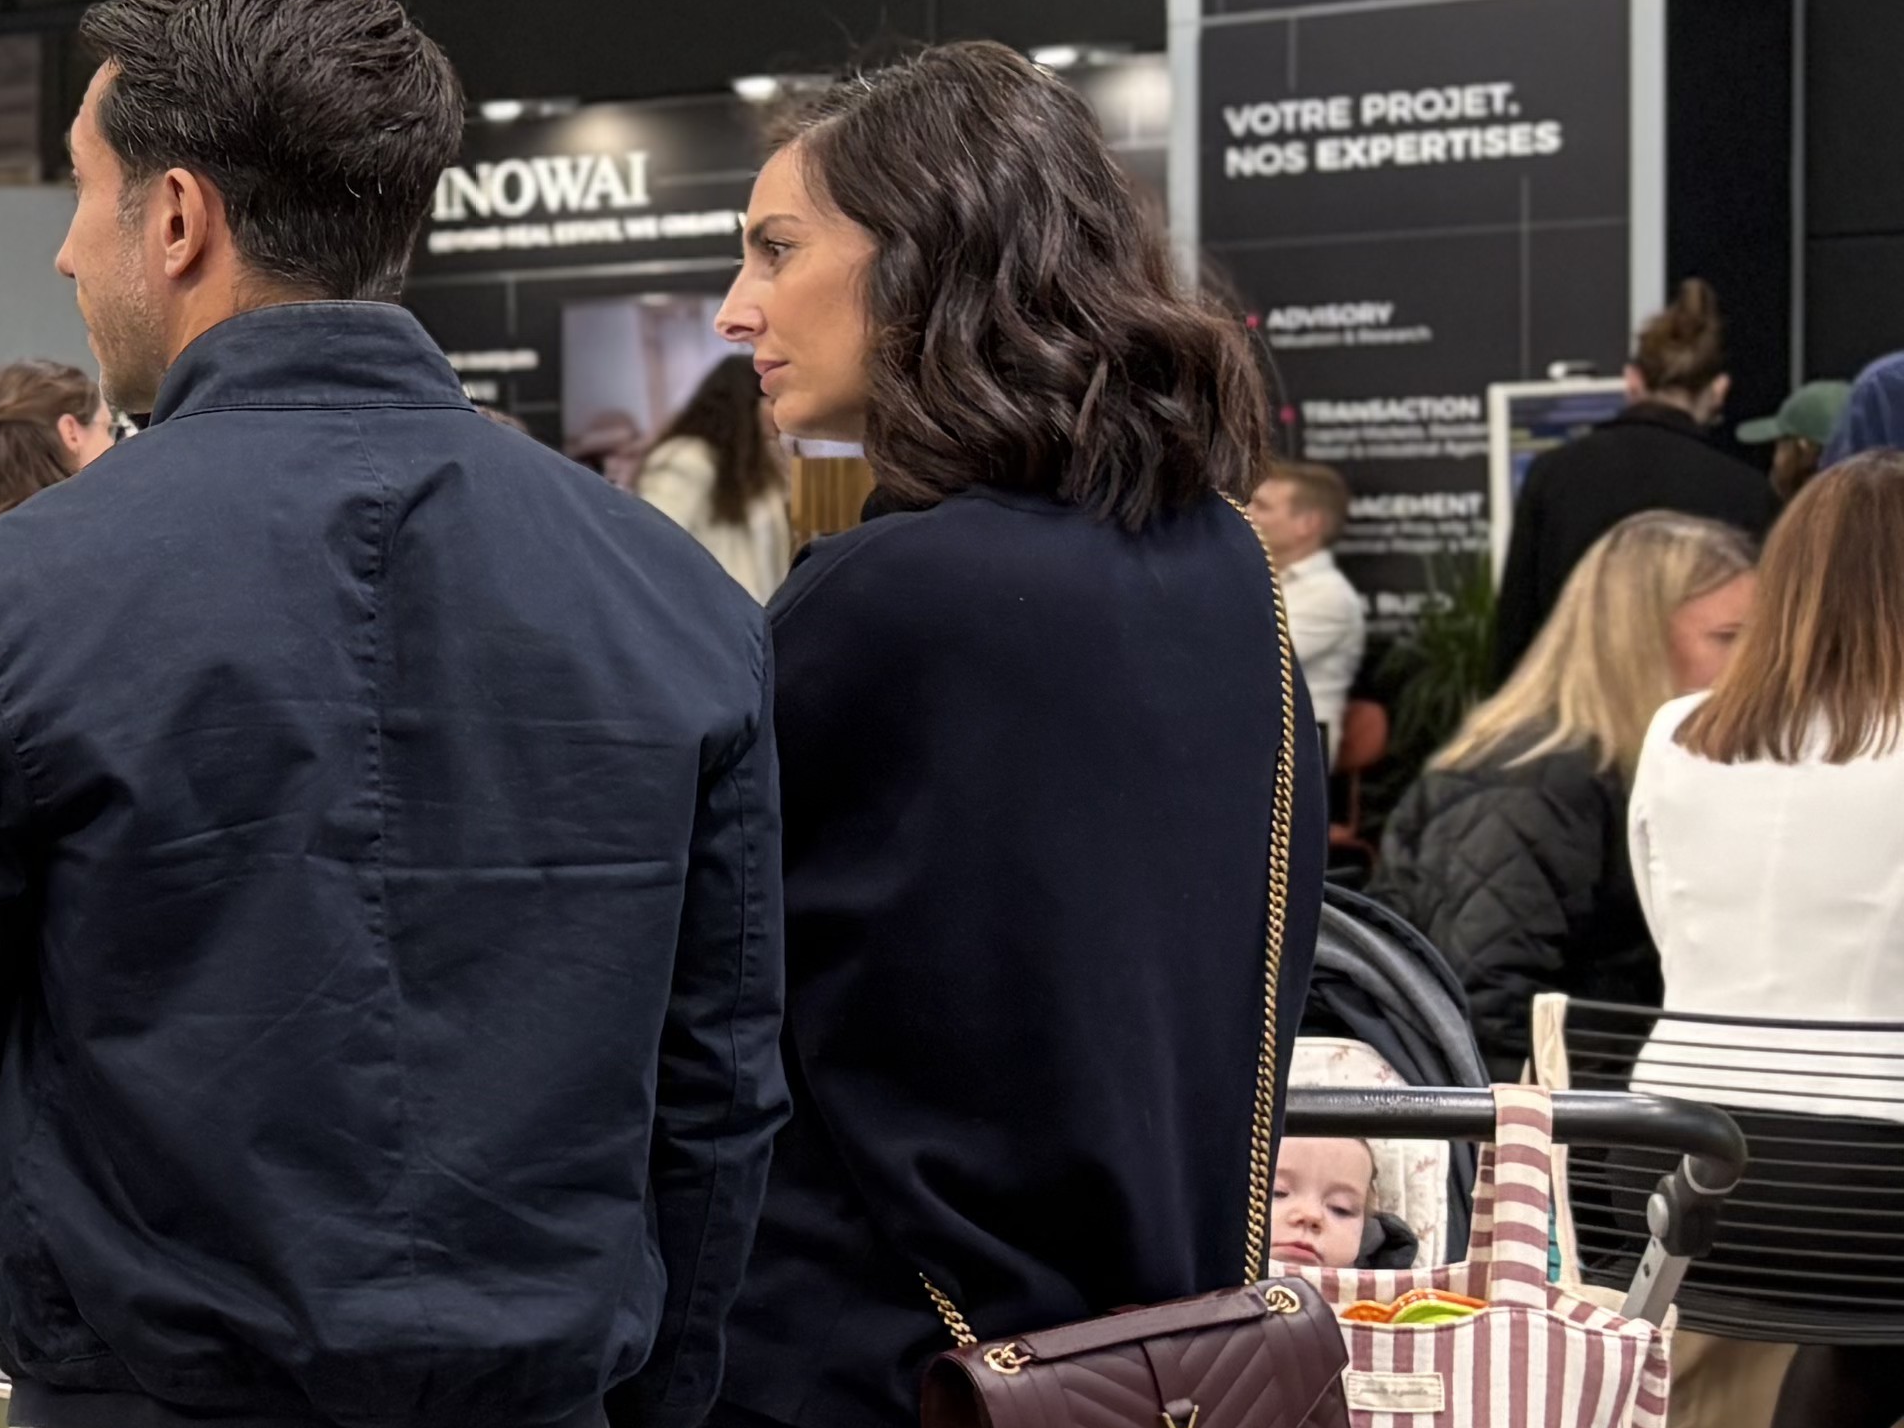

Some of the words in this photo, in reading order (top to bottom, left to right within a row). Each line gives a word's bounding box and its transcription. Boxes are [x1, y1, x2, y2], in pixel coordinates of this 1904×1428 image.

[1223, 96, 1354, 137] VOTRE
[1360, 82, 1521, 124] PROJET.
[1224, 141, 1308, 179] NOS
[1314, 119, 1563, 172] EXPERTISES
[431, 152, 651, 222] INOWAI
[1266, 301, 1394, 330] ADVISORY
[1302, 396, 1480, 423] TRANSACTION
